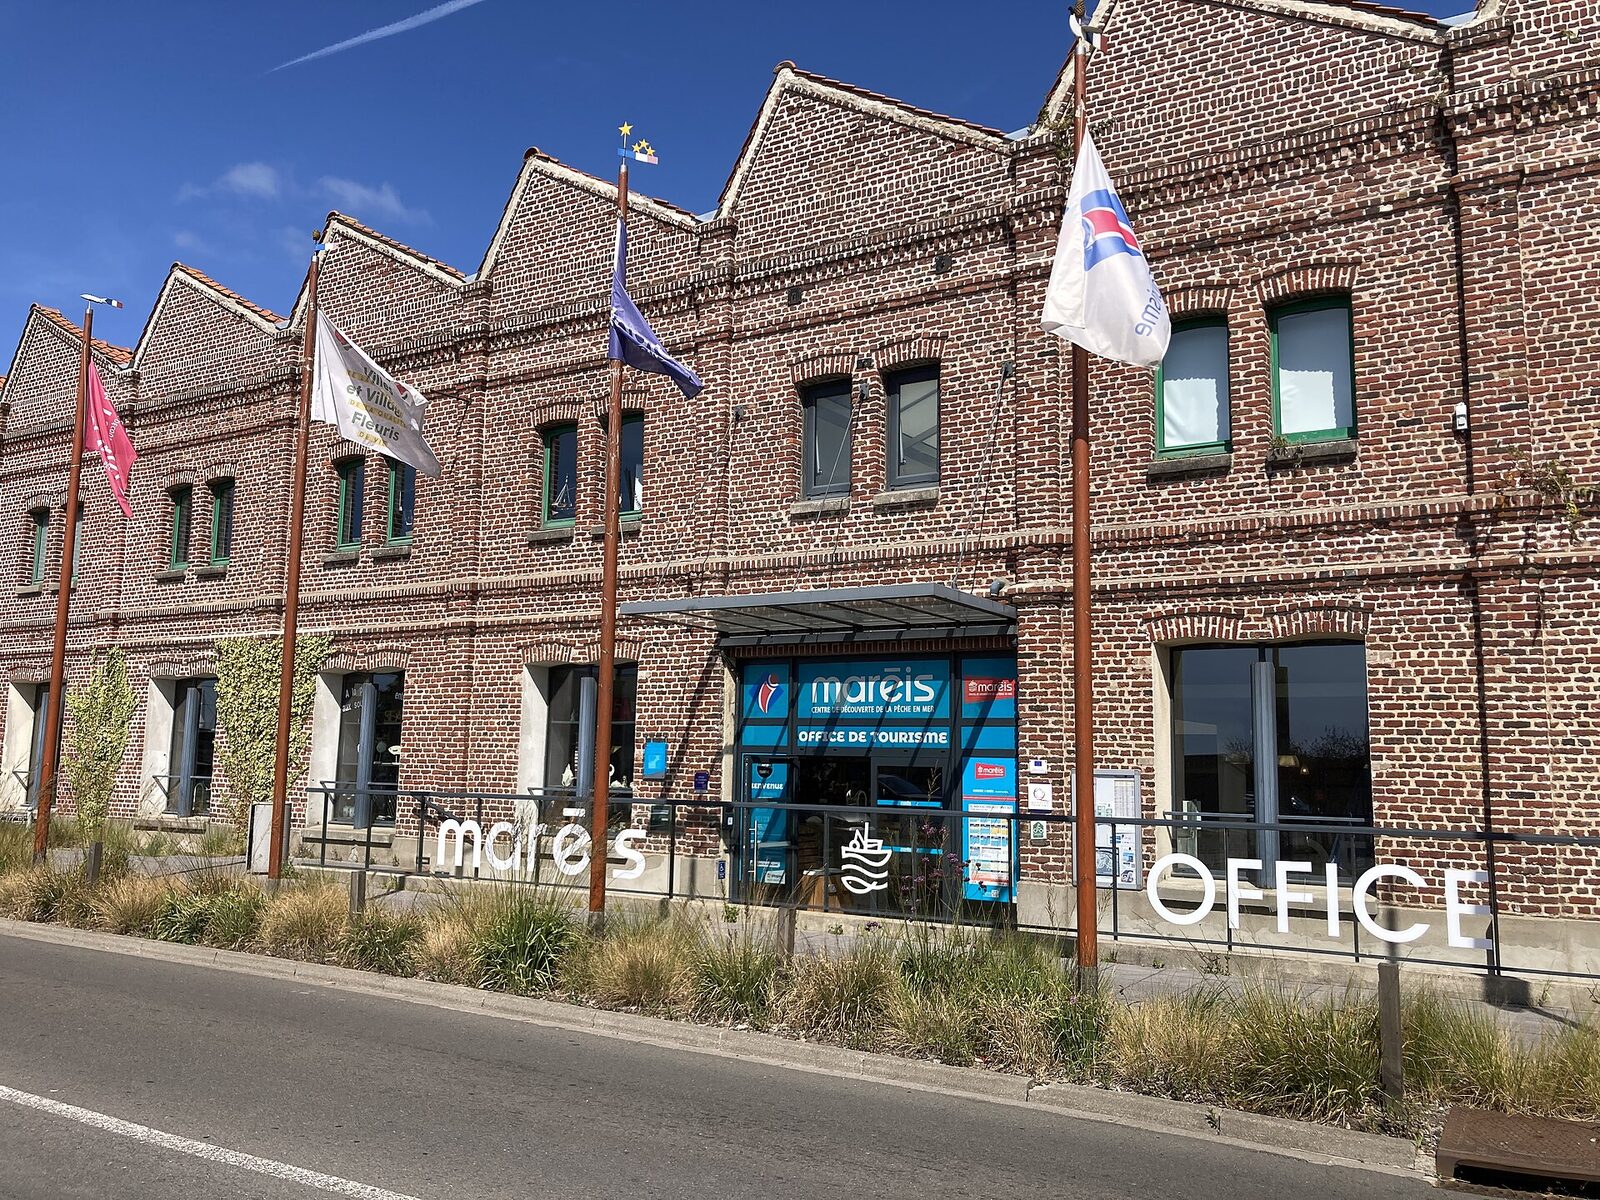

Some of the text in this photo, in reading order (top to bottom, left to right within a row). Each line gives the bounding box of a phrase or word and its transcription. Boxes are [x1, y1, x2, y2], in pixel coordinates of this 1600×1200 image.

[346, 384, 363, 397] et
[351, 410, 400, 441] Fleuris
[811, 706, 831, 714] CENTRE
[841, 704, 875, 714] DÉCOUVERTE
[876, 705, 884, 713] DE
[885, 705, 892, 713] LA
[893, 704, 912, 713] PÊCHE
[922, 705, 935, 713] MER
[798, 730, 948, 744] OFFICE DE TOURISME
[437, 807, 647, 880] marēs
[1146, 852, 1493, 951] OFFICE
